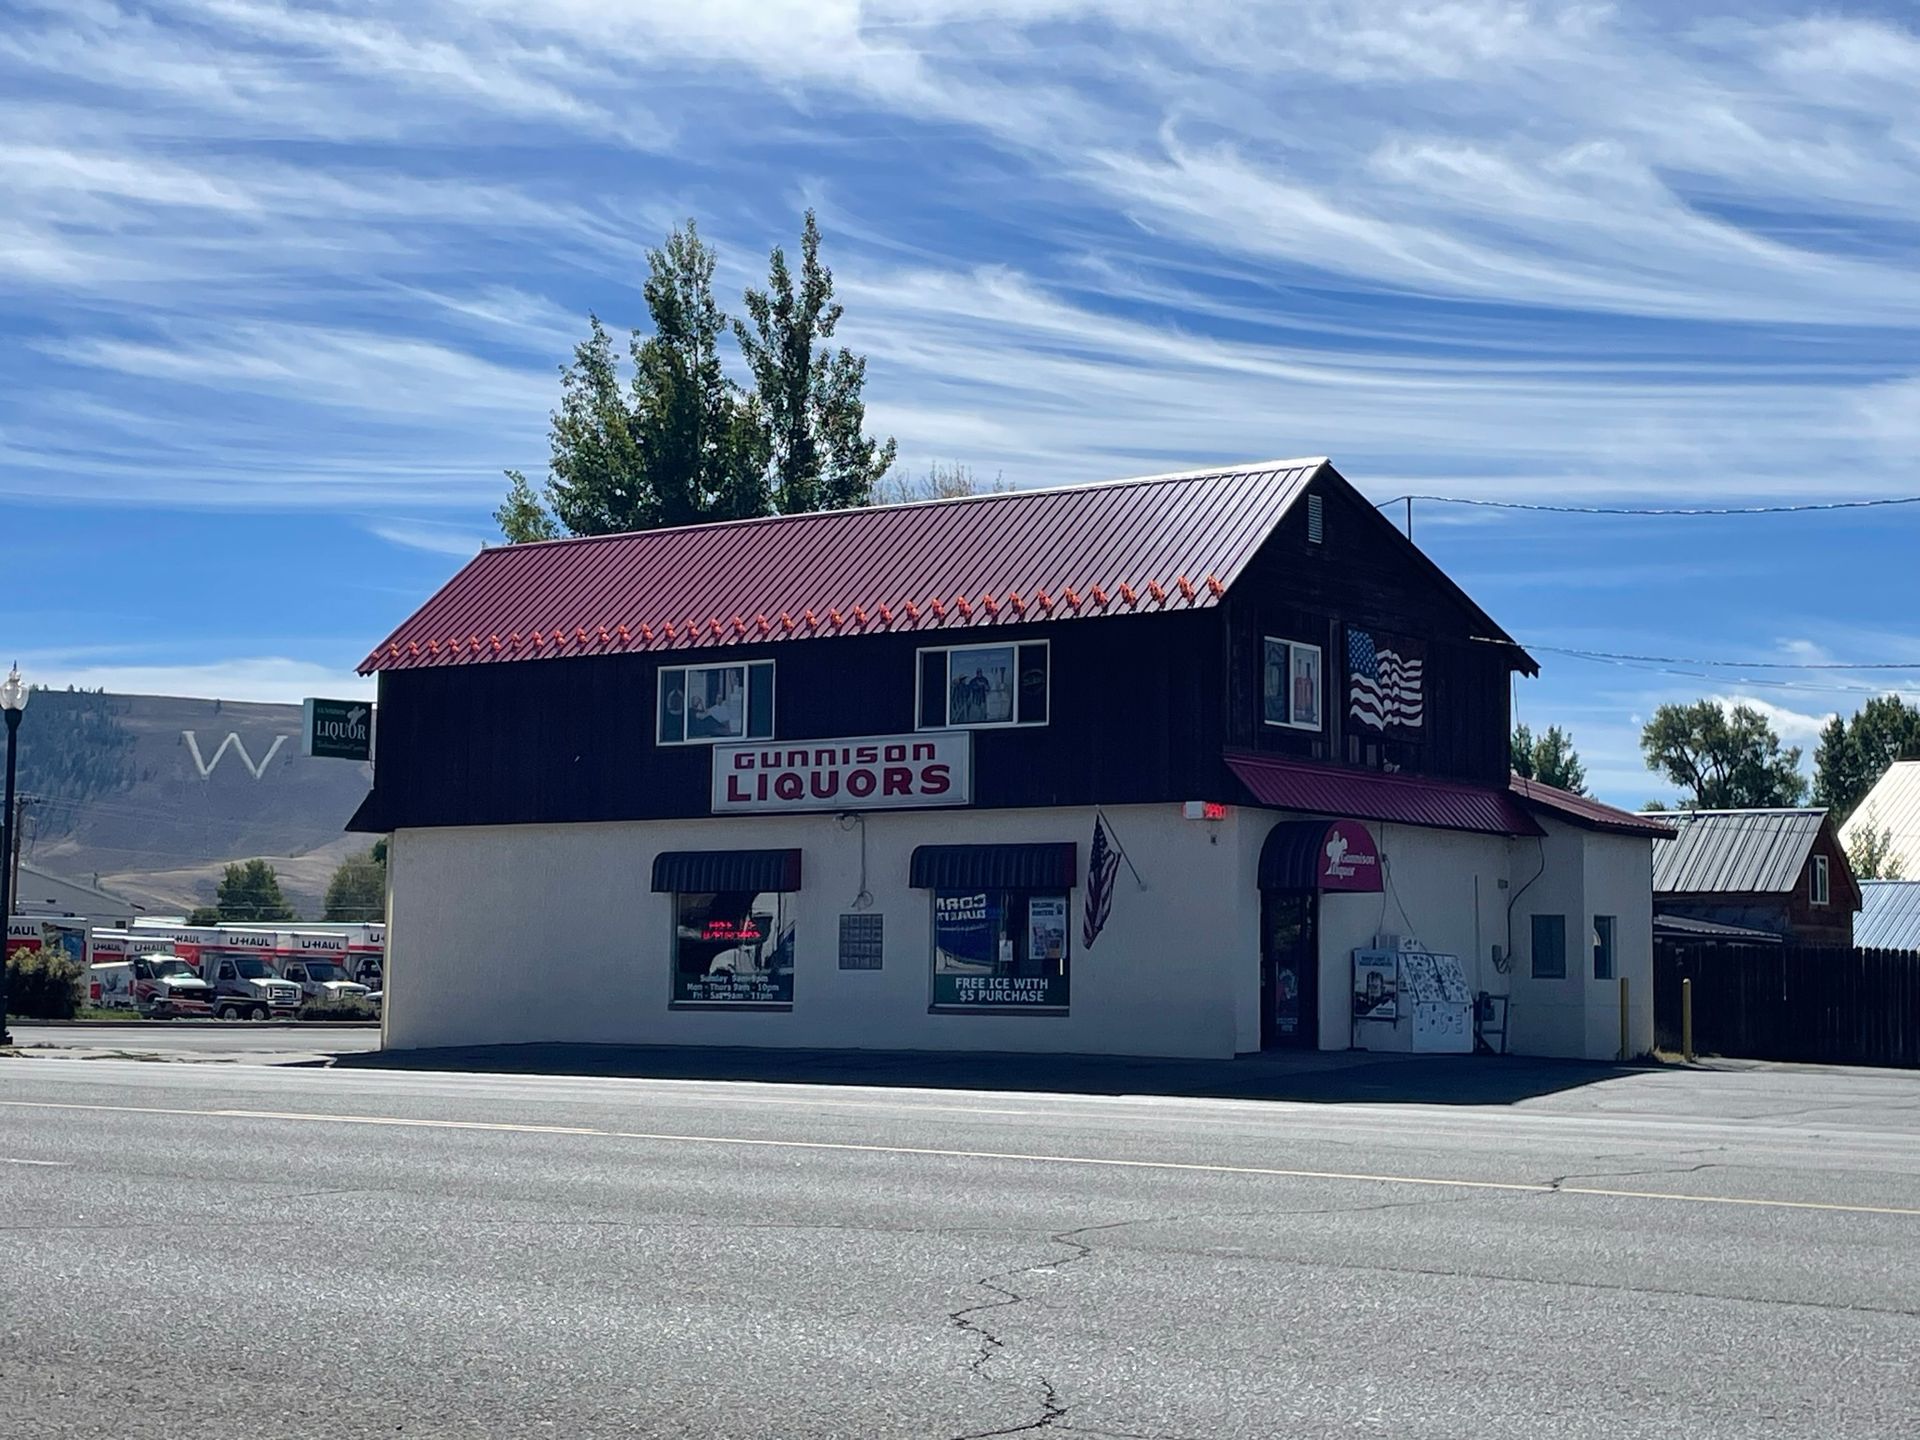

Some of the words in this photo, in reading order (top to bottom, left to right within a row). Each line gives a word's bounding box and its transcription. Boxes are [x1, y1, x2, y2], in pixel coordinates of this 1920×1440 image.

[316, 719, 366, 741] LIQUOR
[182, 730, 288, 780] W
[733, 743, 936, 770] GUNNISON
[727, 764, 950, 802] LIQUORS
[8, 926, 38, 936] HAUL
[93, 943, 122, 951] U-HAUL
[229, 936, 270, 947] U-HAUL
[301, 940, 342, 950] U-HAUL
[134, 944, 168, 952] U-HAUL
[687, 983, 703, 991] Mon
[955, 977, 986, 989] FREE
[988, 978, 1010, 989] ICE
[1013, 978, 1049, 990] WITH
[959, 990, 975, 1002] $5
[979, 990, 1045, 1002] PURCHASE
